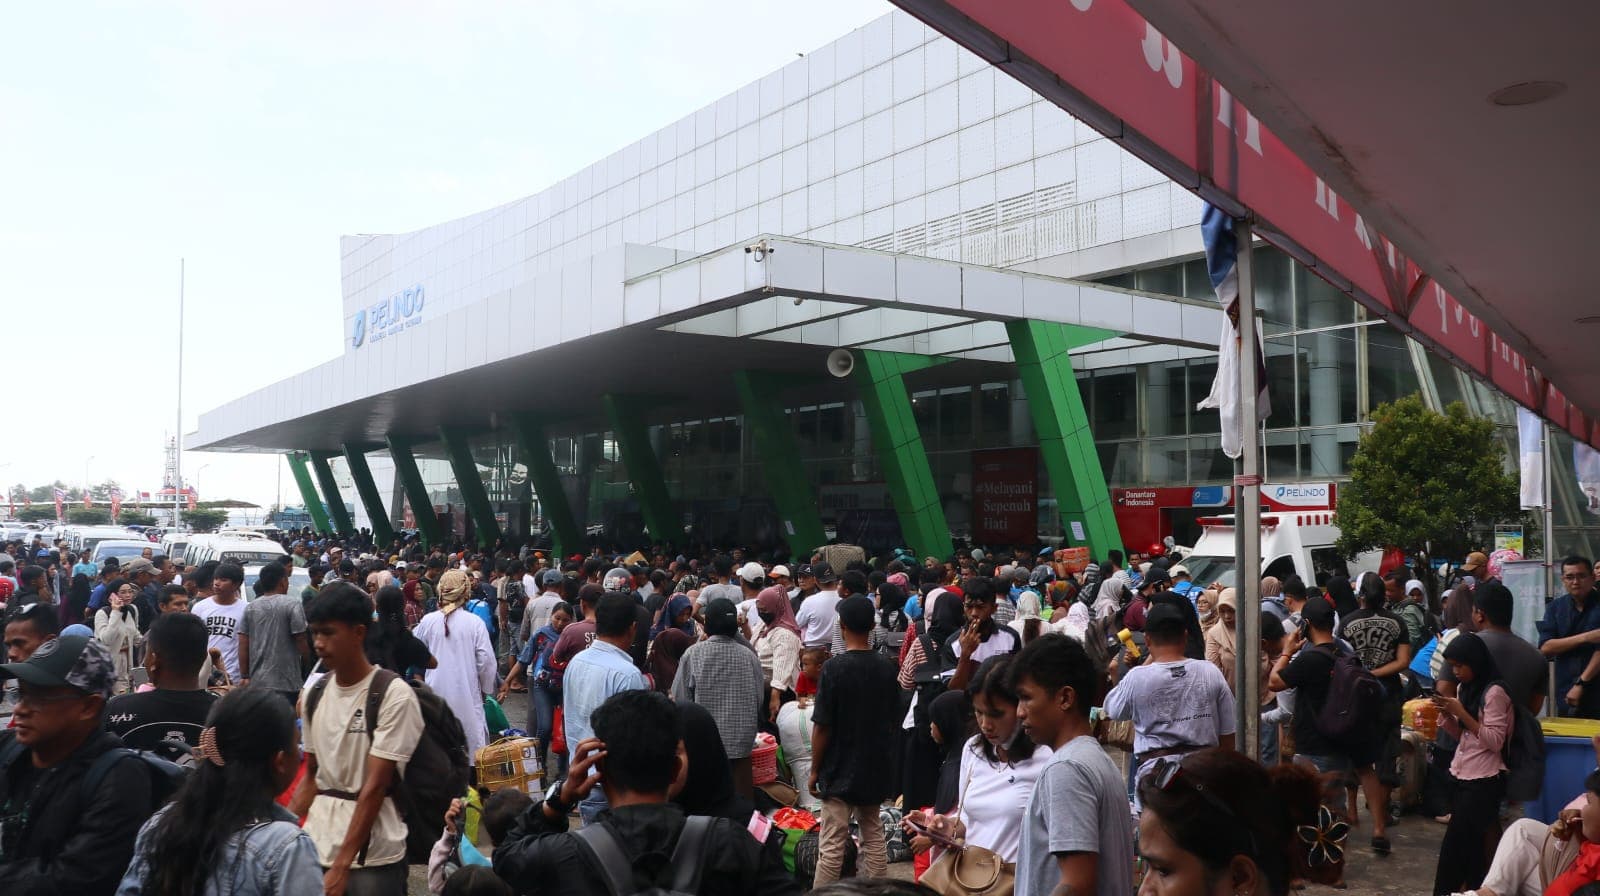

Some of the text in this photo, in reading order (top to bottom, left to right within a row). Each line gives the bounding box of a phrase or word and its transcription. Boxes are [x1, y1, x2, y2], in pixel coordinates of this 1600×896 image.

[369, 284, 424, 333] PELINDO
[975, 480, 1033, 497] #Melayani
[1286, 488, 1326, 497] PELINDO
[984, 499, 1032, 516] Sepenuh
[1125, 498, 1154, 506] Indonesia
[984, 516, 1008, 529] Hati
[206, 615, 236, 628] BULU
